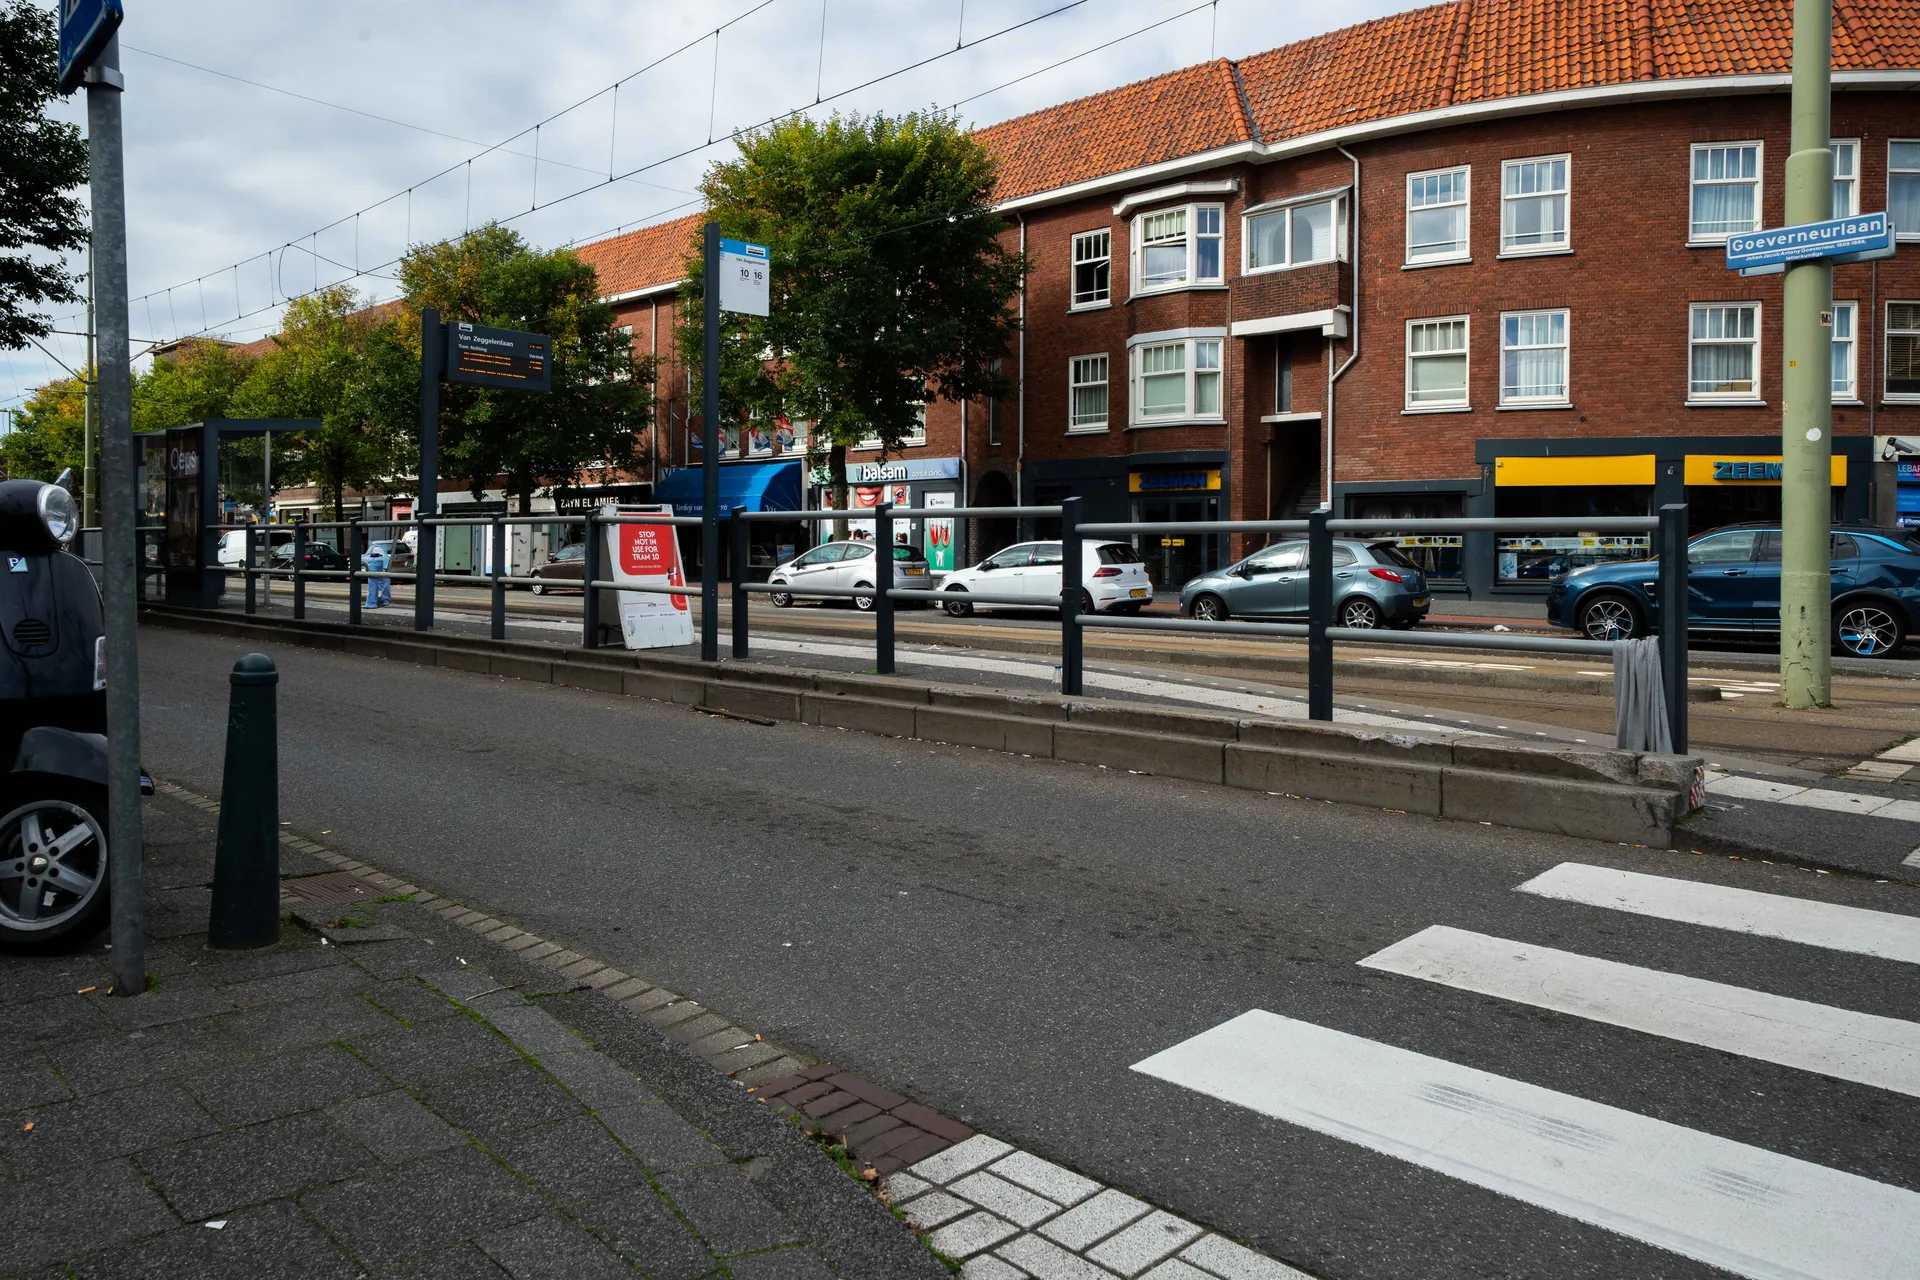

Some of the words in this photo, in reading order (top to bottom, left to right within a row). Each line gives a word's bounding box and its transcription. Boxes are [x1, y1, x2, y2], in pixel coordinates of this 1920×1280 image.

[1732, 219, 1881, 252] Goeverneurlaan
[740, 268, 750, 278] 10
[753, 271, 763, 280] 16
[458, 333, 471, 341] Van
[473, 335, 514, 347] Zeggelenlaan
[170, 447, 197, 471] Oeps
[863, 464, 907, 480] balsam
[1713, 461, 1782, 480] ZEEM
[1139, 472, 1207, 489] ZEEMAN
[560, 499, 580, 508] ZAYN
[582, 498, 592, 508] EL
[632, 545, 644, 553] USE
[645, 545, 659, 553] FOR
[634, 538, 648, 546] NOT
